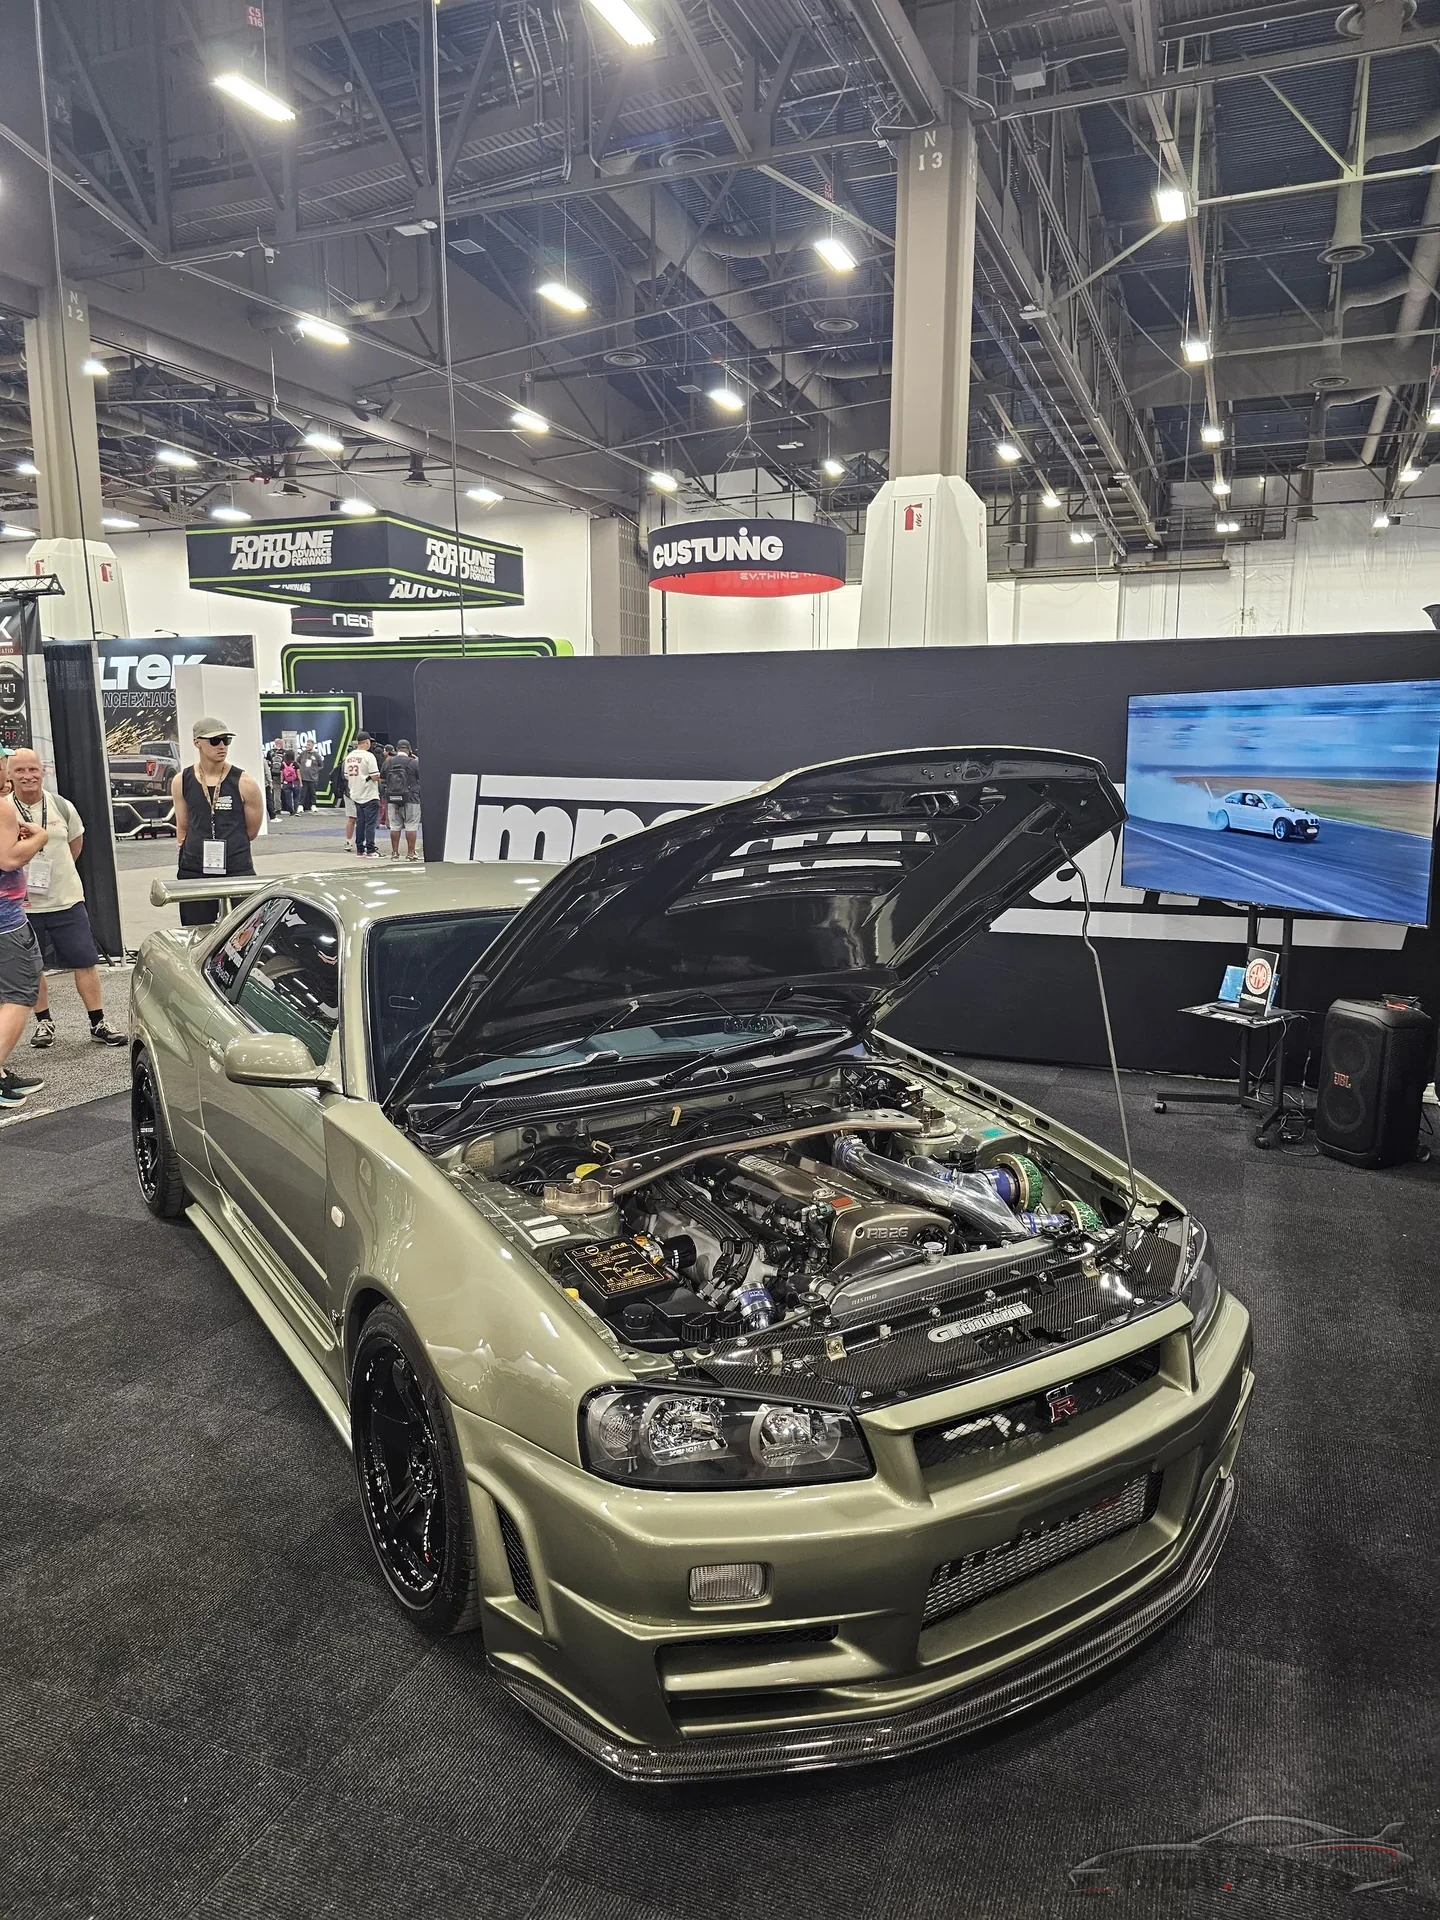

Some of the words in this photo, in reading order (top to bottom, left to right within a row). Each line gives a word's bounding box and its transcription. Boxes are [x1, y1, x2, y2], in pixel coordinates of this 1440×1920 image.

[924, 130, 937, 148] N
[918, 151, 943, 171] 13
[70, 290, 79, 304] N
[68, 305, 84, 322] 12
[230, 529, 334, 554] FORTUNE
[231, 550, 293, 570] AUTO
[291, 556, 333, 566] FORWARD
[292, 547, 332, 558] ADVANCE
[426, 537, 496, 568] FORTUNE
[427, 555, 470, 579] AUTO
[128, 690, 177, 708] EXHAUS
[348, 765, 359, 776] 23
[1333, 1071, 1351, 1088] JBL
[866, 1226, 909, 1240] RB26
[927, 1322, 962, 1342] GT
[960, 1313, 1004, 1335] COOLING
[1002, 1303, 1033, 1323] PANEL
